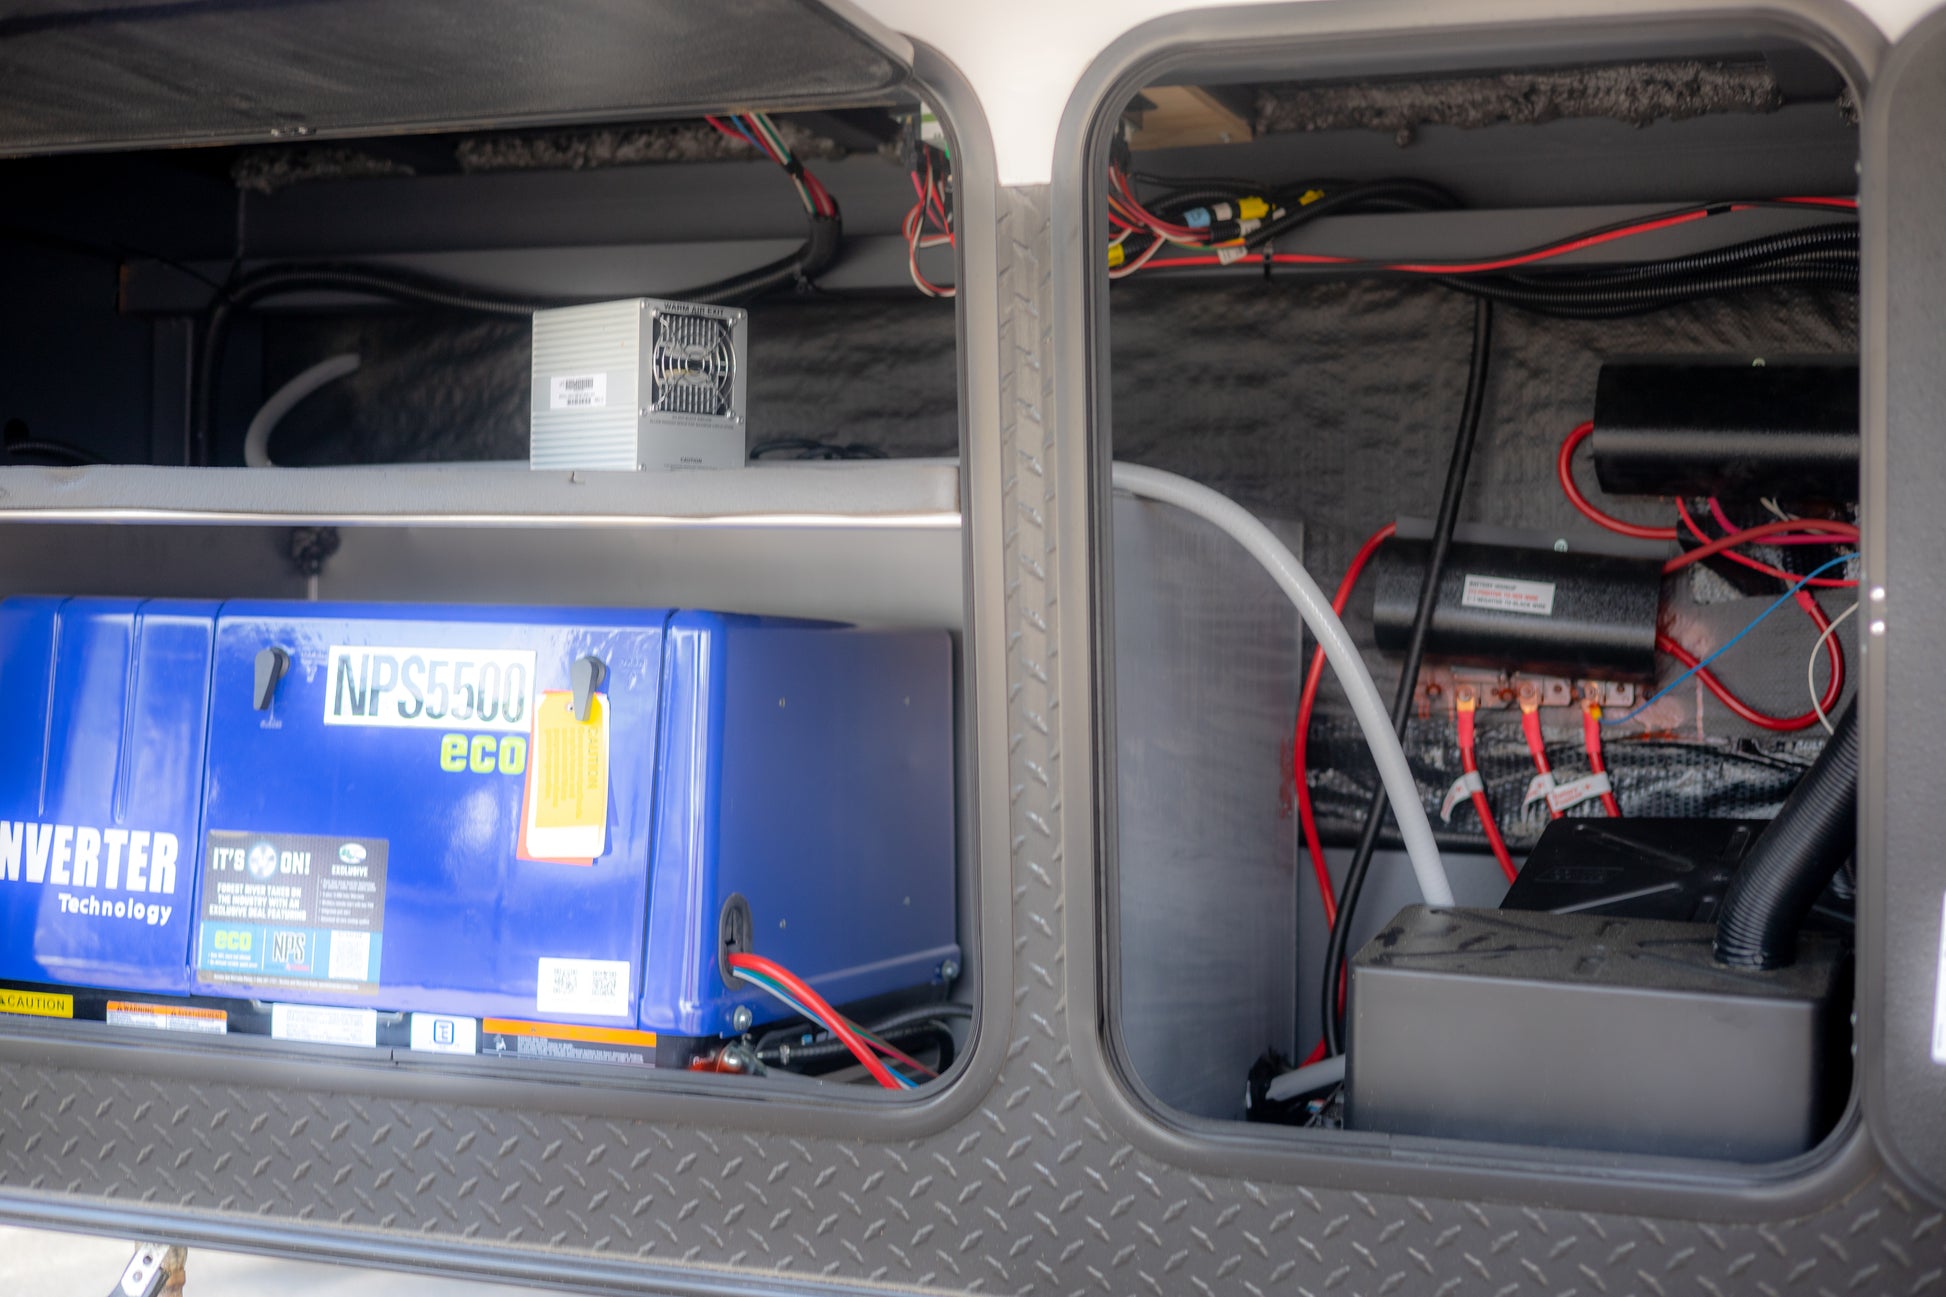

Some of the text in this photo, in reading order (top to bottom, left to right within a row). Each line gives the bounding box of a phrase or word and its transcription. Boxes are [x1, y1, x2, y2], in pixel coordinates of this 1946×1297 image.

[664, 302, 724, 316] WARM AIR EXIT
[333, 653, 527, 723] NPS5500
[440, 733, 527, 775] eco
[0, 820, 179, 895] NVERTER
[212, 847, 312, 876] IT'S ON!
[332, 864, 369, 878] EXCLUSIVE
[58, 893, 173, 926] Technology
[214, 930, 252, 950] eco
[272, 931, 306, 964] NPS
[7, 994, 65, 1011] CAUTION
[124, 1005, 154, 1015] WARNING
